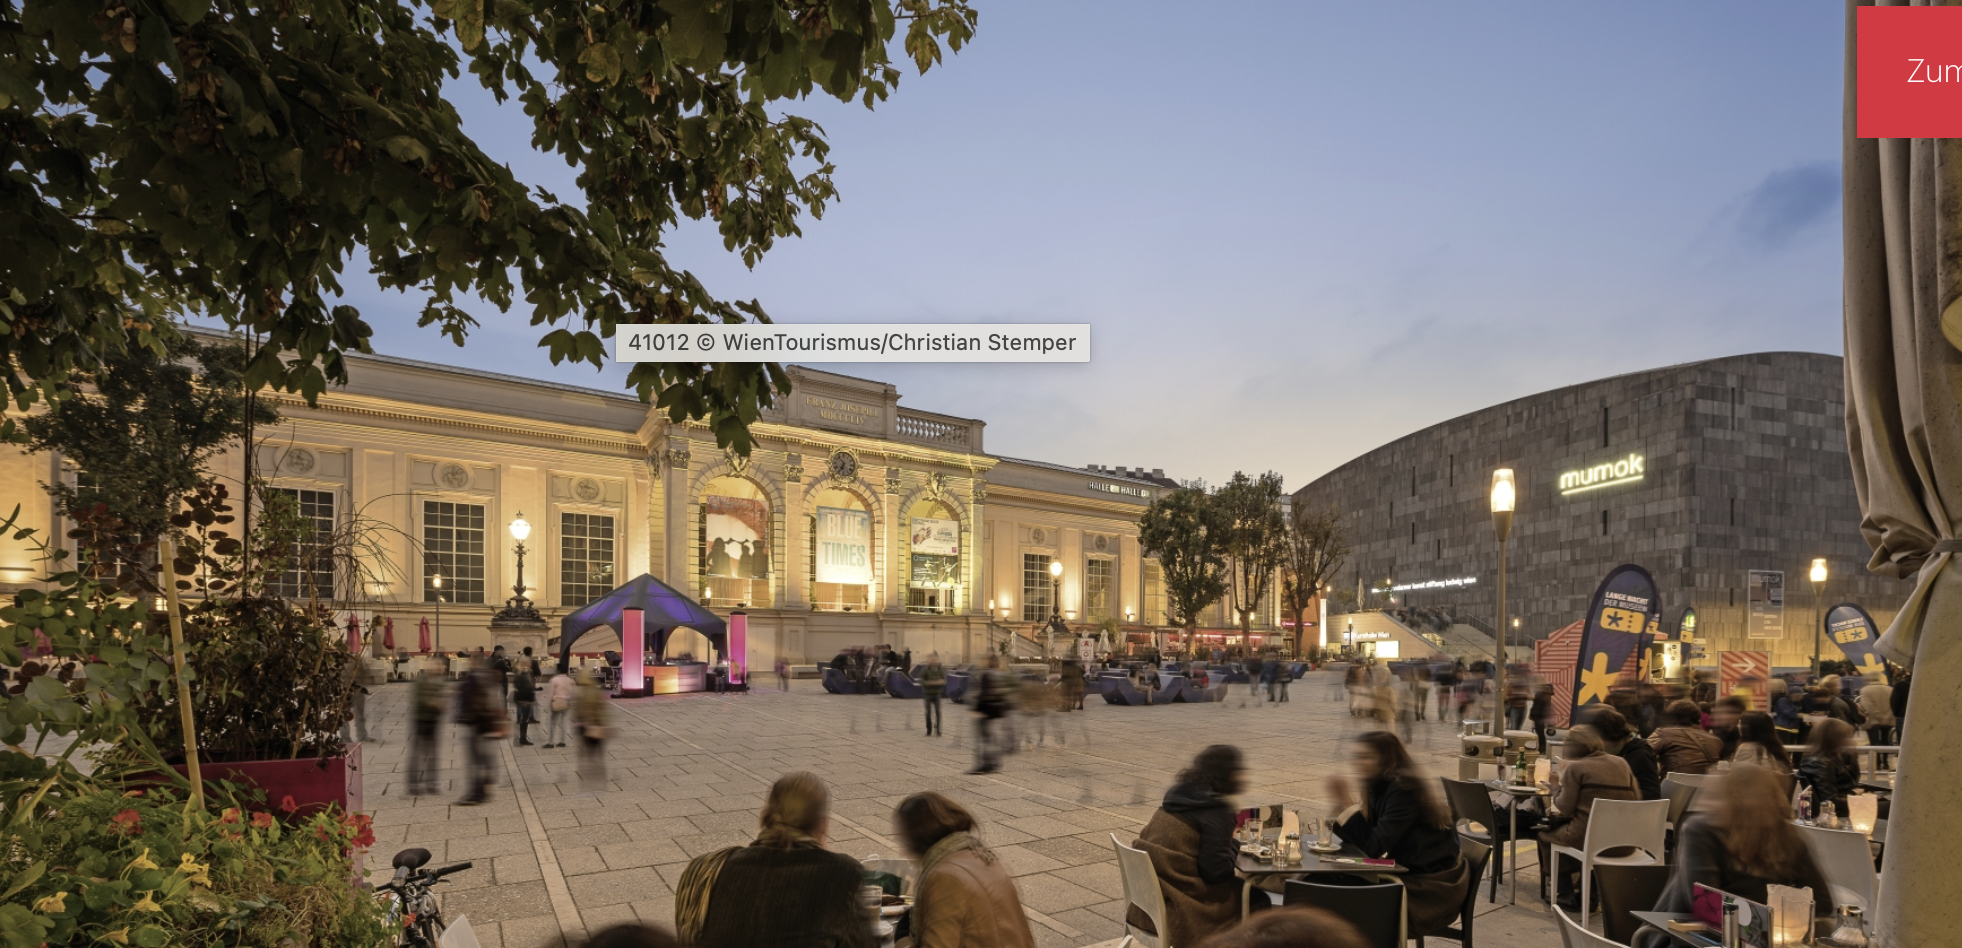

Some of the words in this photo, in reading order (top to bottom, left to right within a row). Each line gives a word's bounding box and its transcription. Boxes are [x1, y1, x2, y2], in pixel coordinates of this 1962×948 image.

[806, 396, 837, 411] FRANZ
[1560, 453, 1644, 489] mumok
[1089, 481, 1110, 492] HALLE
[1121, 486, 1141, 497] HALLE
[827, 514, 862, 539] BLUE
[822, 541, 866, 567] TIMES
[1603, 599, 1618, 607] DER
[1605, 591, 1627, 601] LANGE
